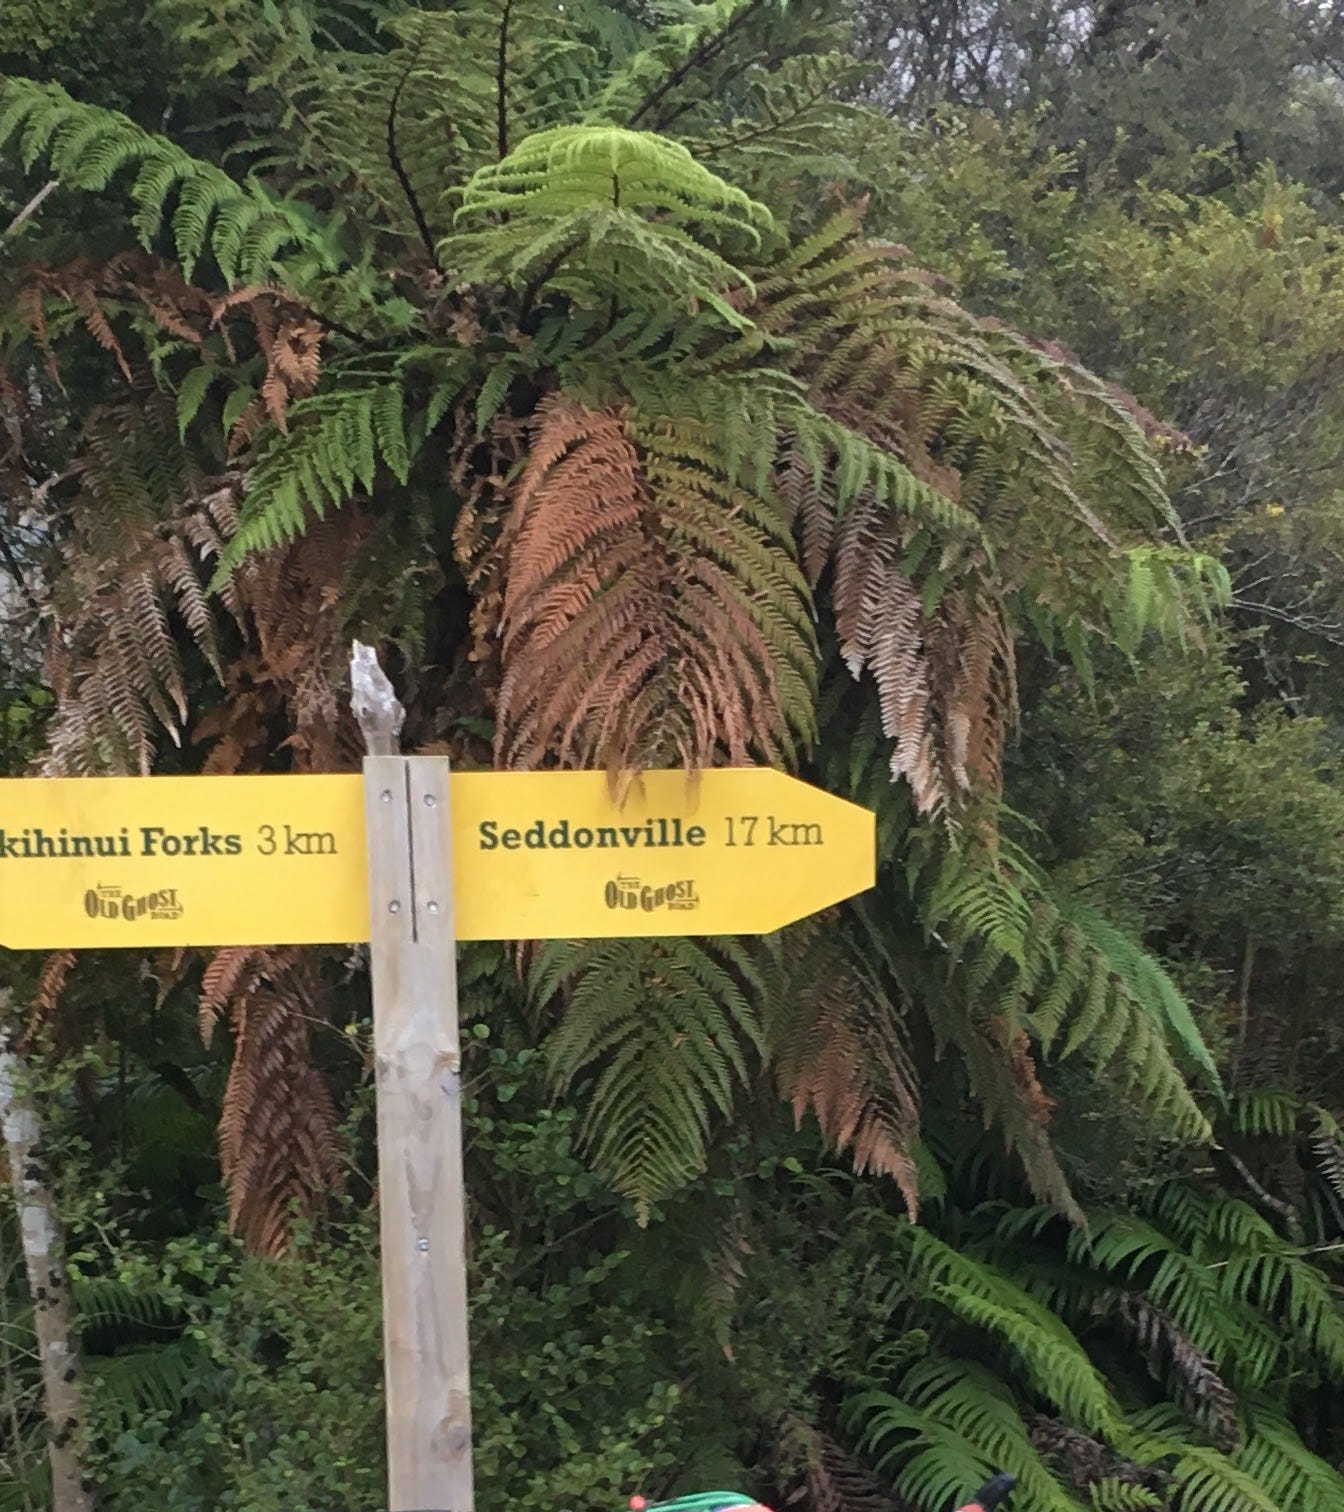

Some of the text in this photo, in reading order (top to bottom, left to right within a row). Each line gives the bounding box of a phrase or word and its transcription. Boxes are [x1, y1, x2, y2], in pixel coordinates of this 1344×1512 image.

[139, 826, 243, 857] Forks
[256, 824, 277, 856] 3
[283, 824, 339, 856] km
[479, 816, 825, 851] Seddonville 17 km
